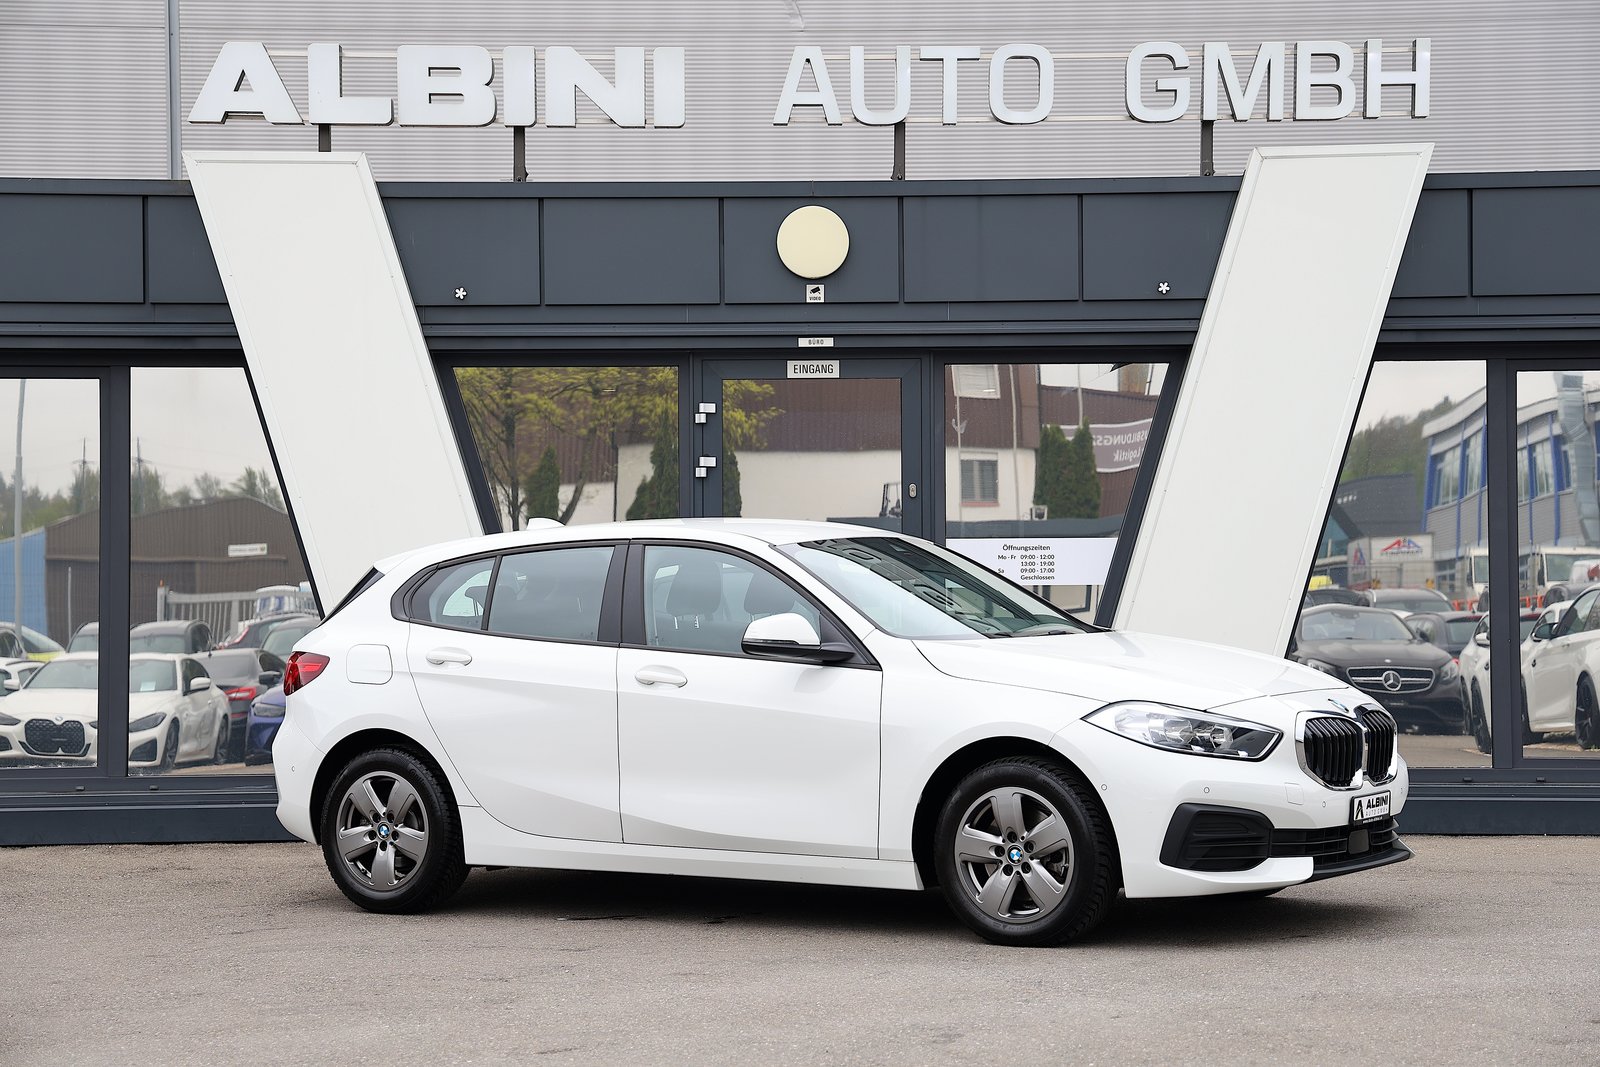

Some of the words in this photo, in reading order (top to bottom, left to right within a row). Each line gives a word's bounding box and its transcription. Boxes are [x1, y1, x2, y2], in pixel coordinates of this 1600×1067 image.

[187, 41, 686, 128] ALBINI
[772, 43, 1055, 126] AUTO
[1125, 38, 1431, 122] GMBH
[793, 364, 834, 374] EINGANG
[1002, 544, 1051, 552] Öffnungszeiten
